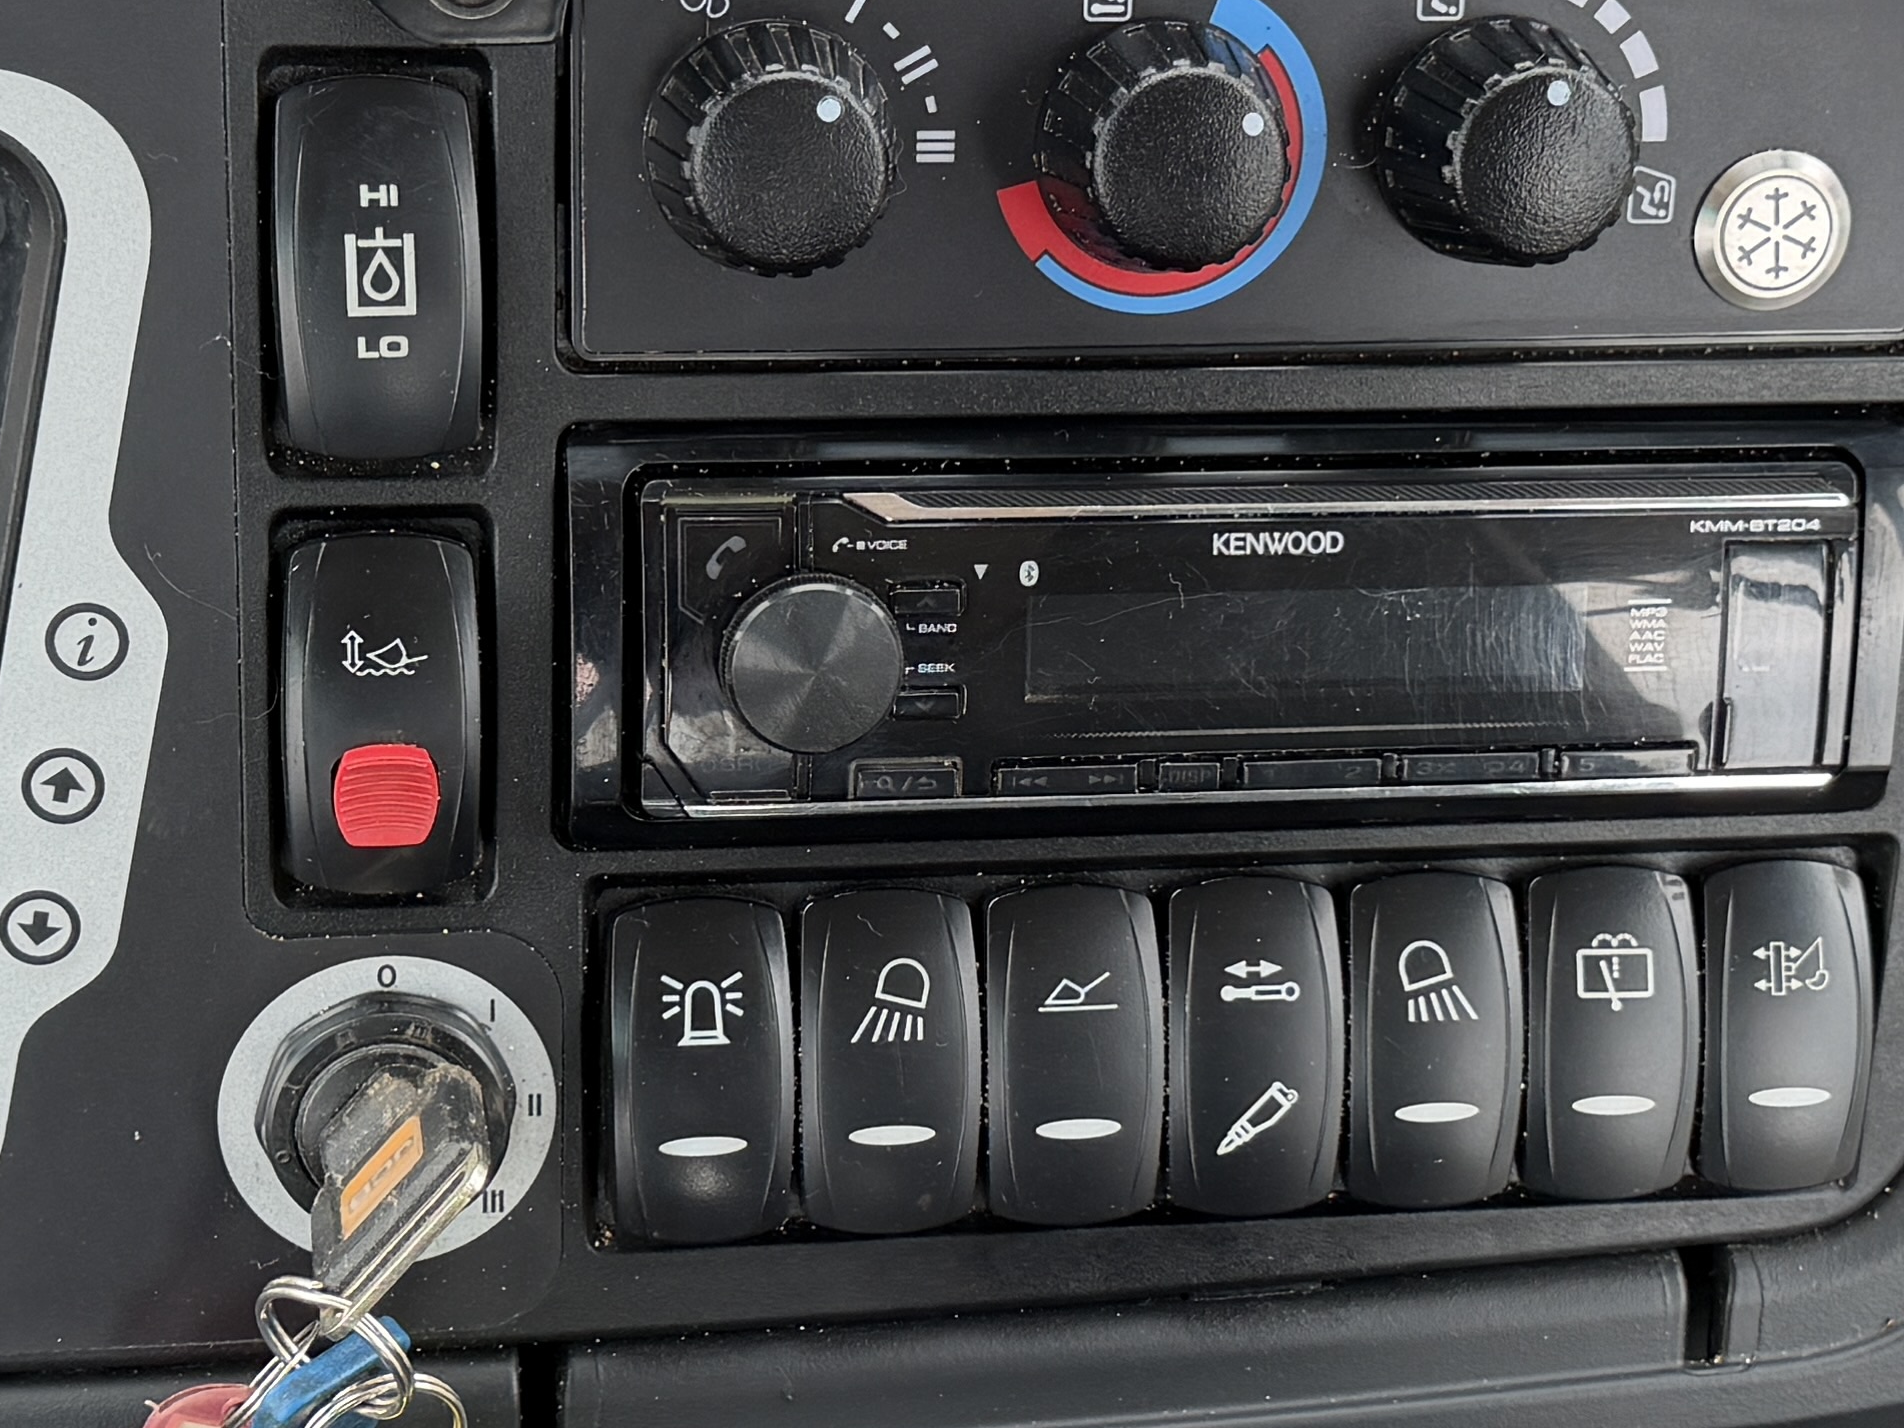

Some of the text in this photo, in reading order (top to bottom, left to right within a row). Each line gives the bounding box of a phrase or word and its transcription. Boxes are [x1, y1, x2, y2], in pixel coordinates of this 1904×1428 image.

[360, 184, 399, 207] HI
[358, 336, 409, 359] LO
[1213, 531, 1344, 555] KENWOOD
[918, 623, 957, 634] BAND
[918, 663, 956, 674] SEEK
